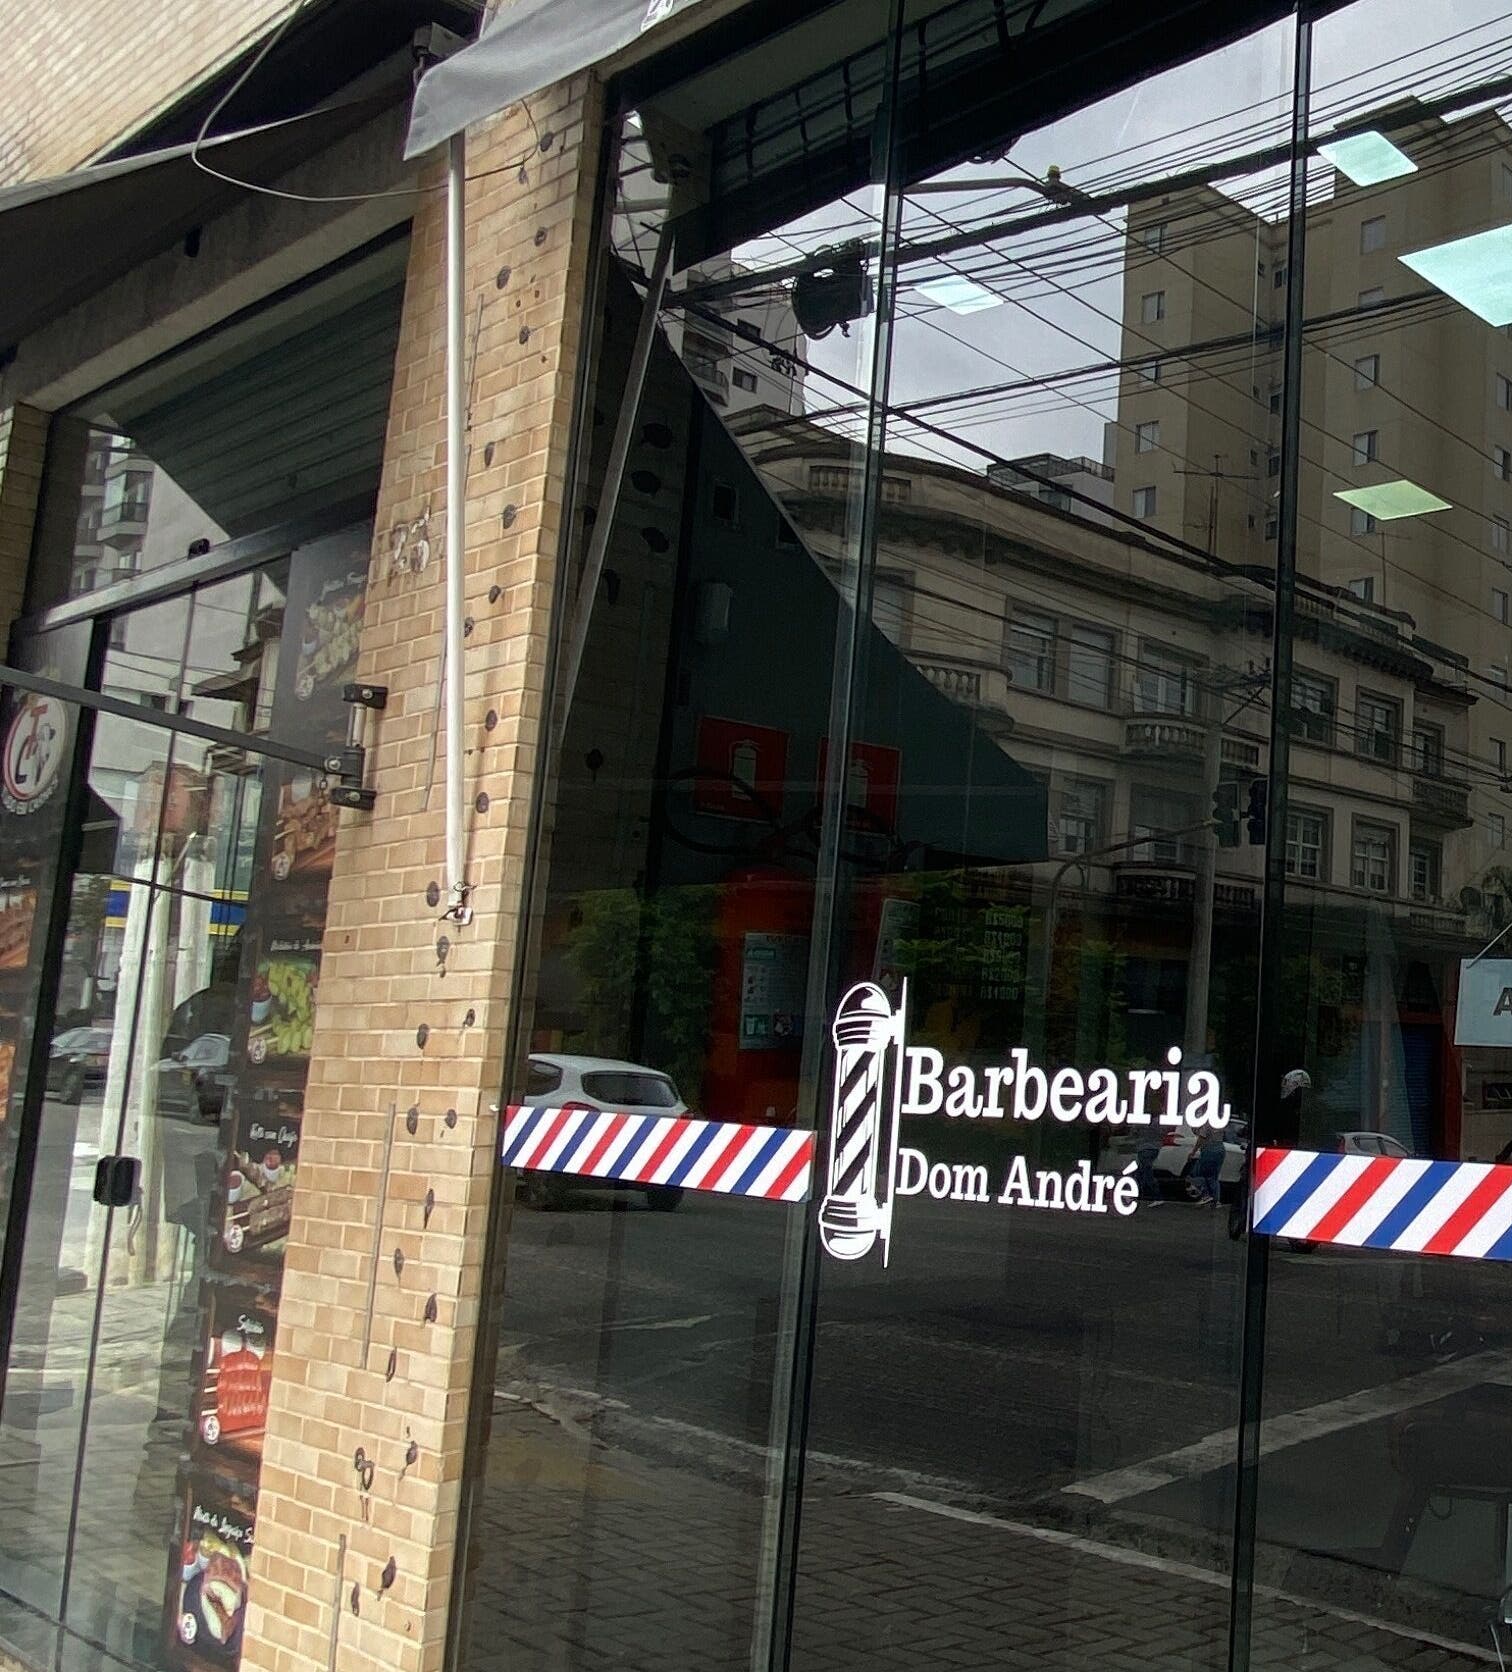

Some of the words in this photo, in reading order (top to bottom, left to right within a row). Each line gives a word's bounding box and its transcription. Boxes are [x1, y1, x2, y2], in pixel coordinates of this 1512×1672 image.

[901, 1046, 1231, 1129] Barbearia
[895, 1148, 990, 1202] Dom
[997, 1156, 1139, 1216] André
